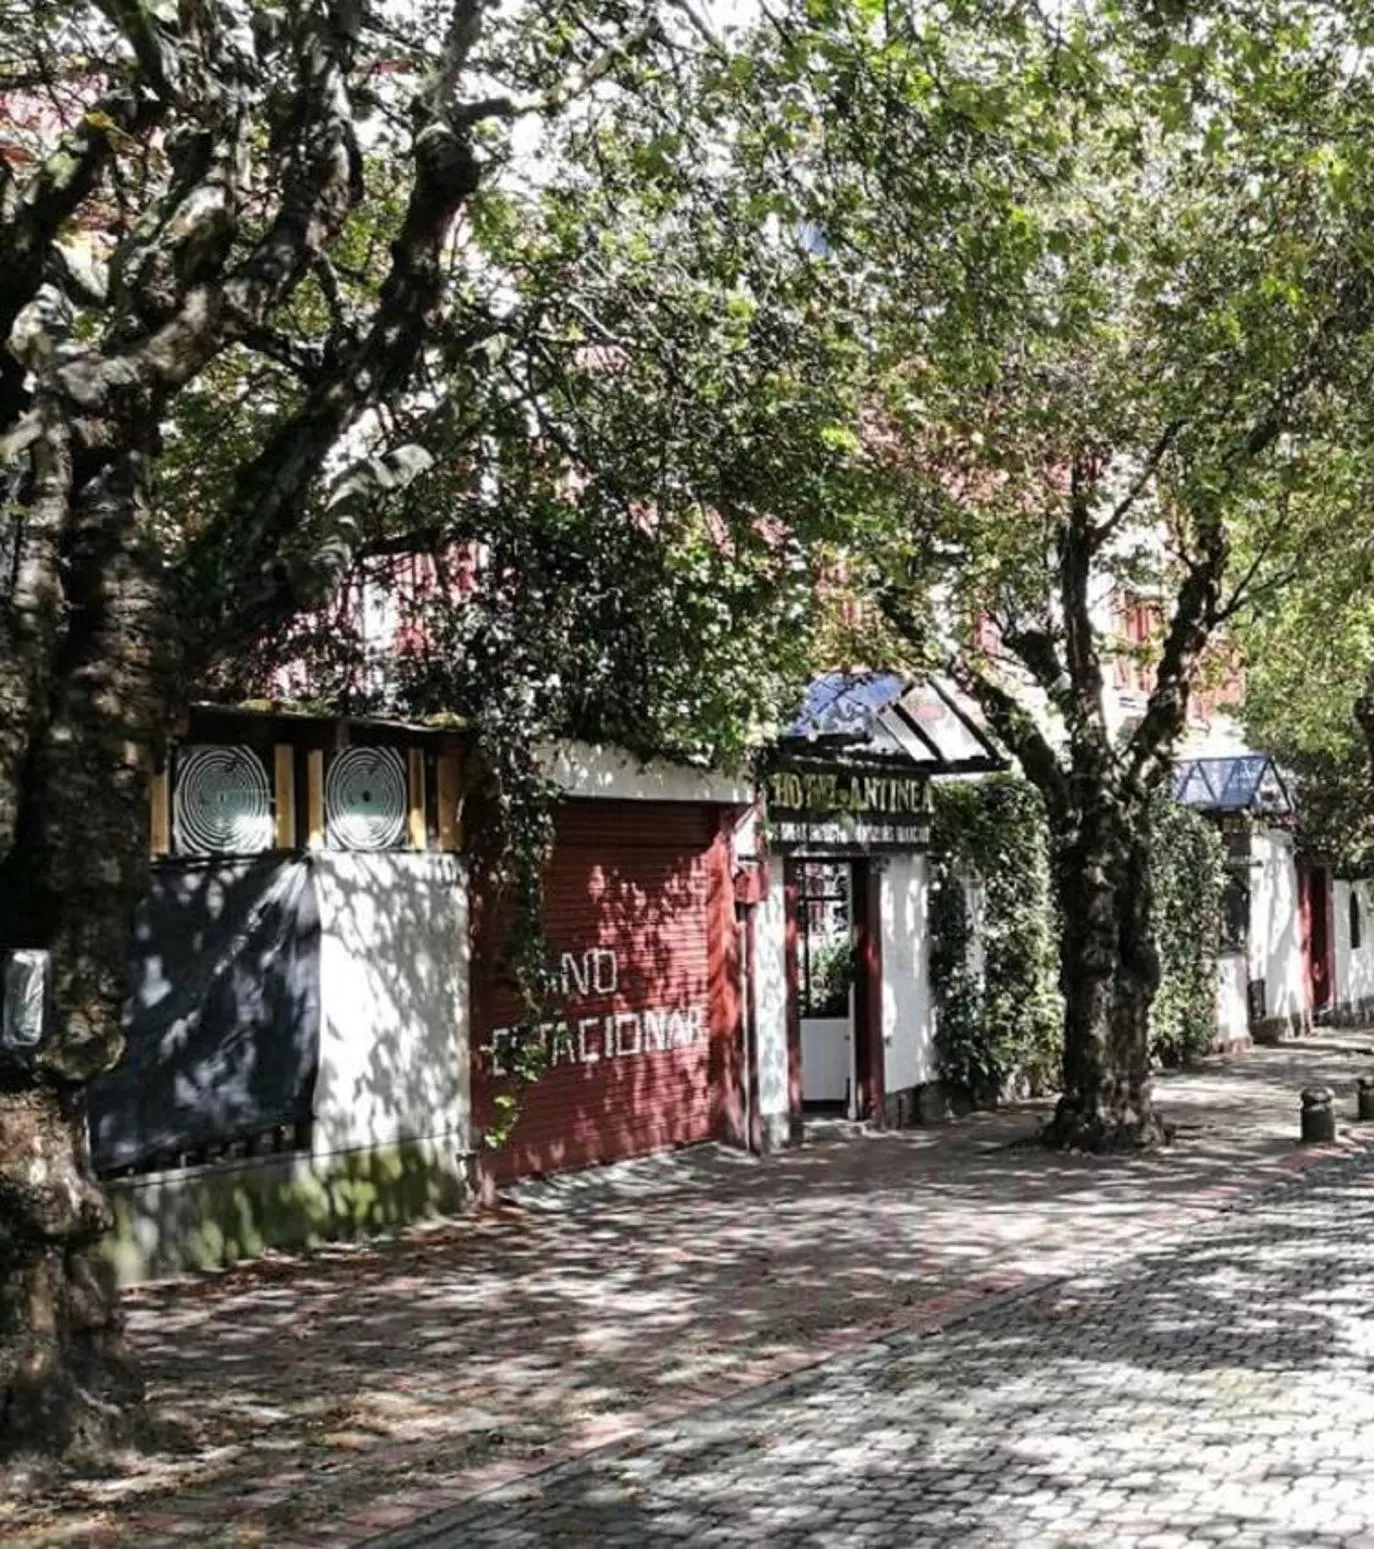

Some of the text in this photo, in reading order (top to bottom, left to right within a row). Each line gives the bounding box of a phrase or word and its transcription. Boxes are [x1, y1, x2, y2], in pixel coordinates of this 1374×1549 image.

[771, 772, 843, 810] HOTL
[560, 948, 618, 995] NO
[492, 1006, 702, 1077] ETACIONAR
